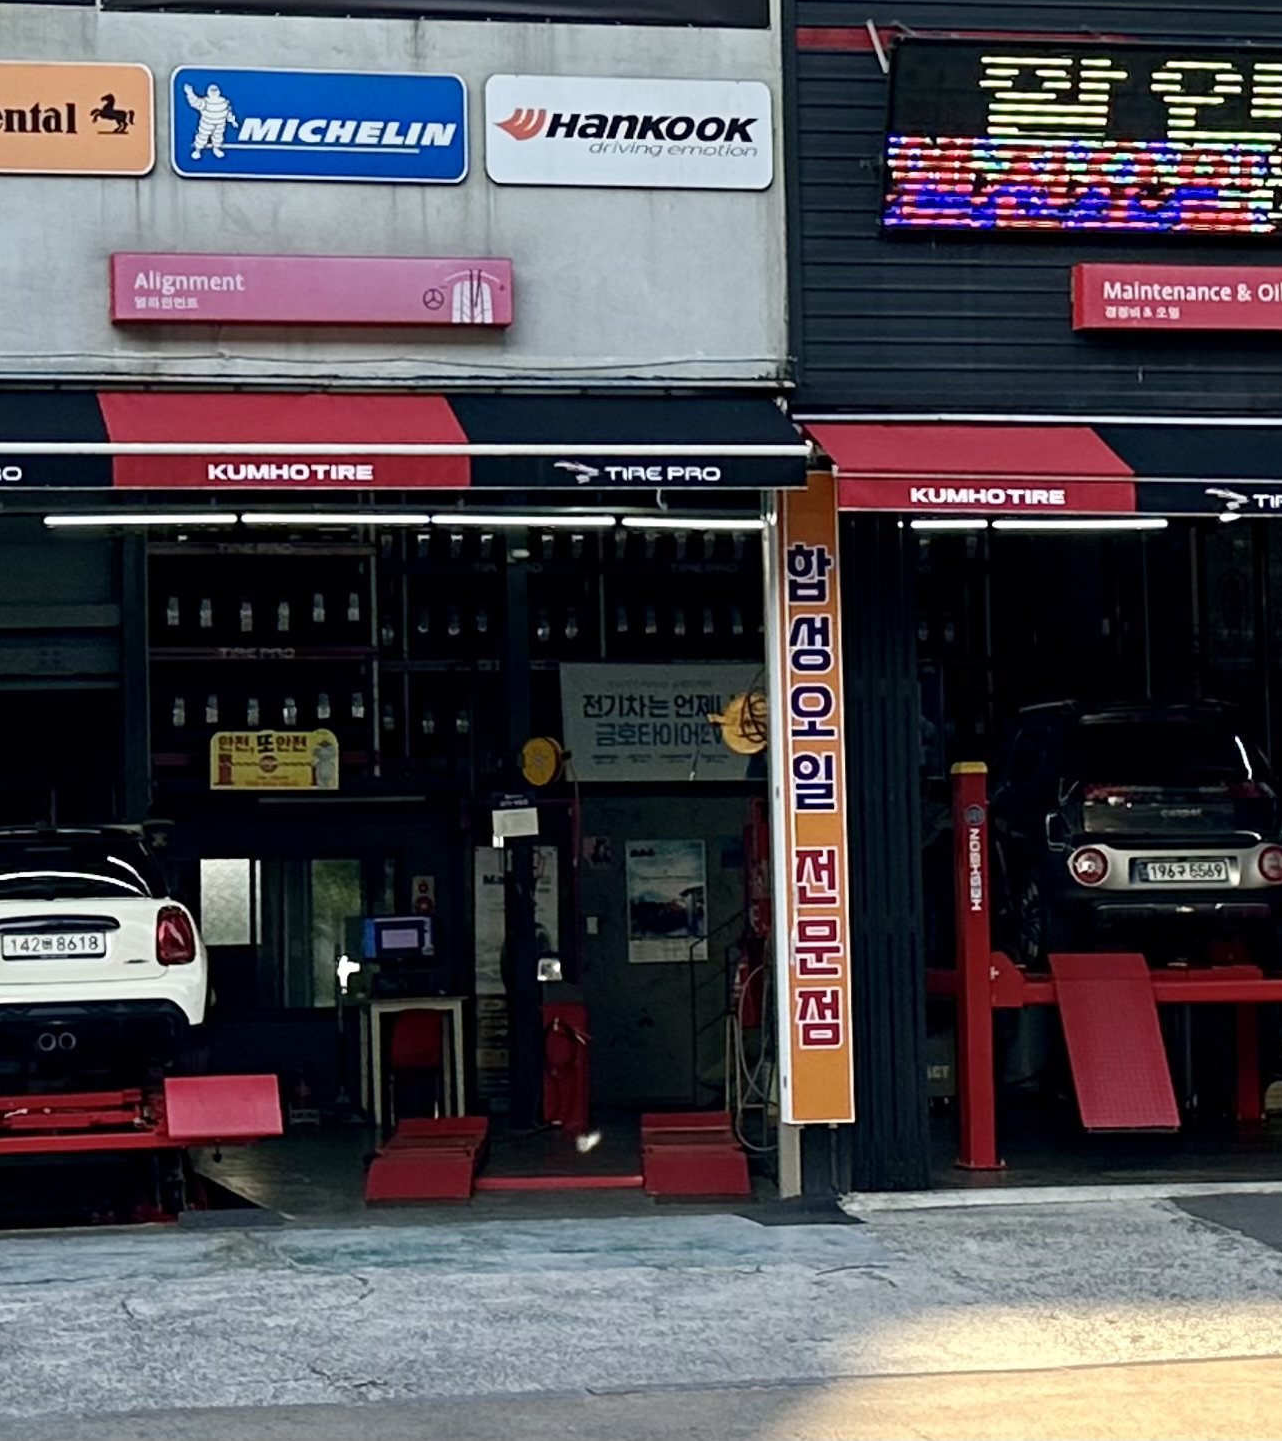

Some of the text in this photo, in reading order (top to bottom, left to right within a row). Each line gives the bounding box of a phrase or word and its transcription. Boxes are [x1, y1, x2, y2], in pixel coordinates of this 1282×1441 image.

[238, 116, 457, 147] MICHELIN
[589, 140, 758, 158] driving emotion
[134, 270, 246, 295] Alignment
[1103, 281, 1232, 301] Maintenance
[1237, 283, 1252, 301] &
[604, 464, 722, 482] TIRE PRO
[583, 694, 722, 719] 전기차는 언제
[595, 723, 699, 748] 금호타이어
[795, 848, 841, 1047] 전문점
